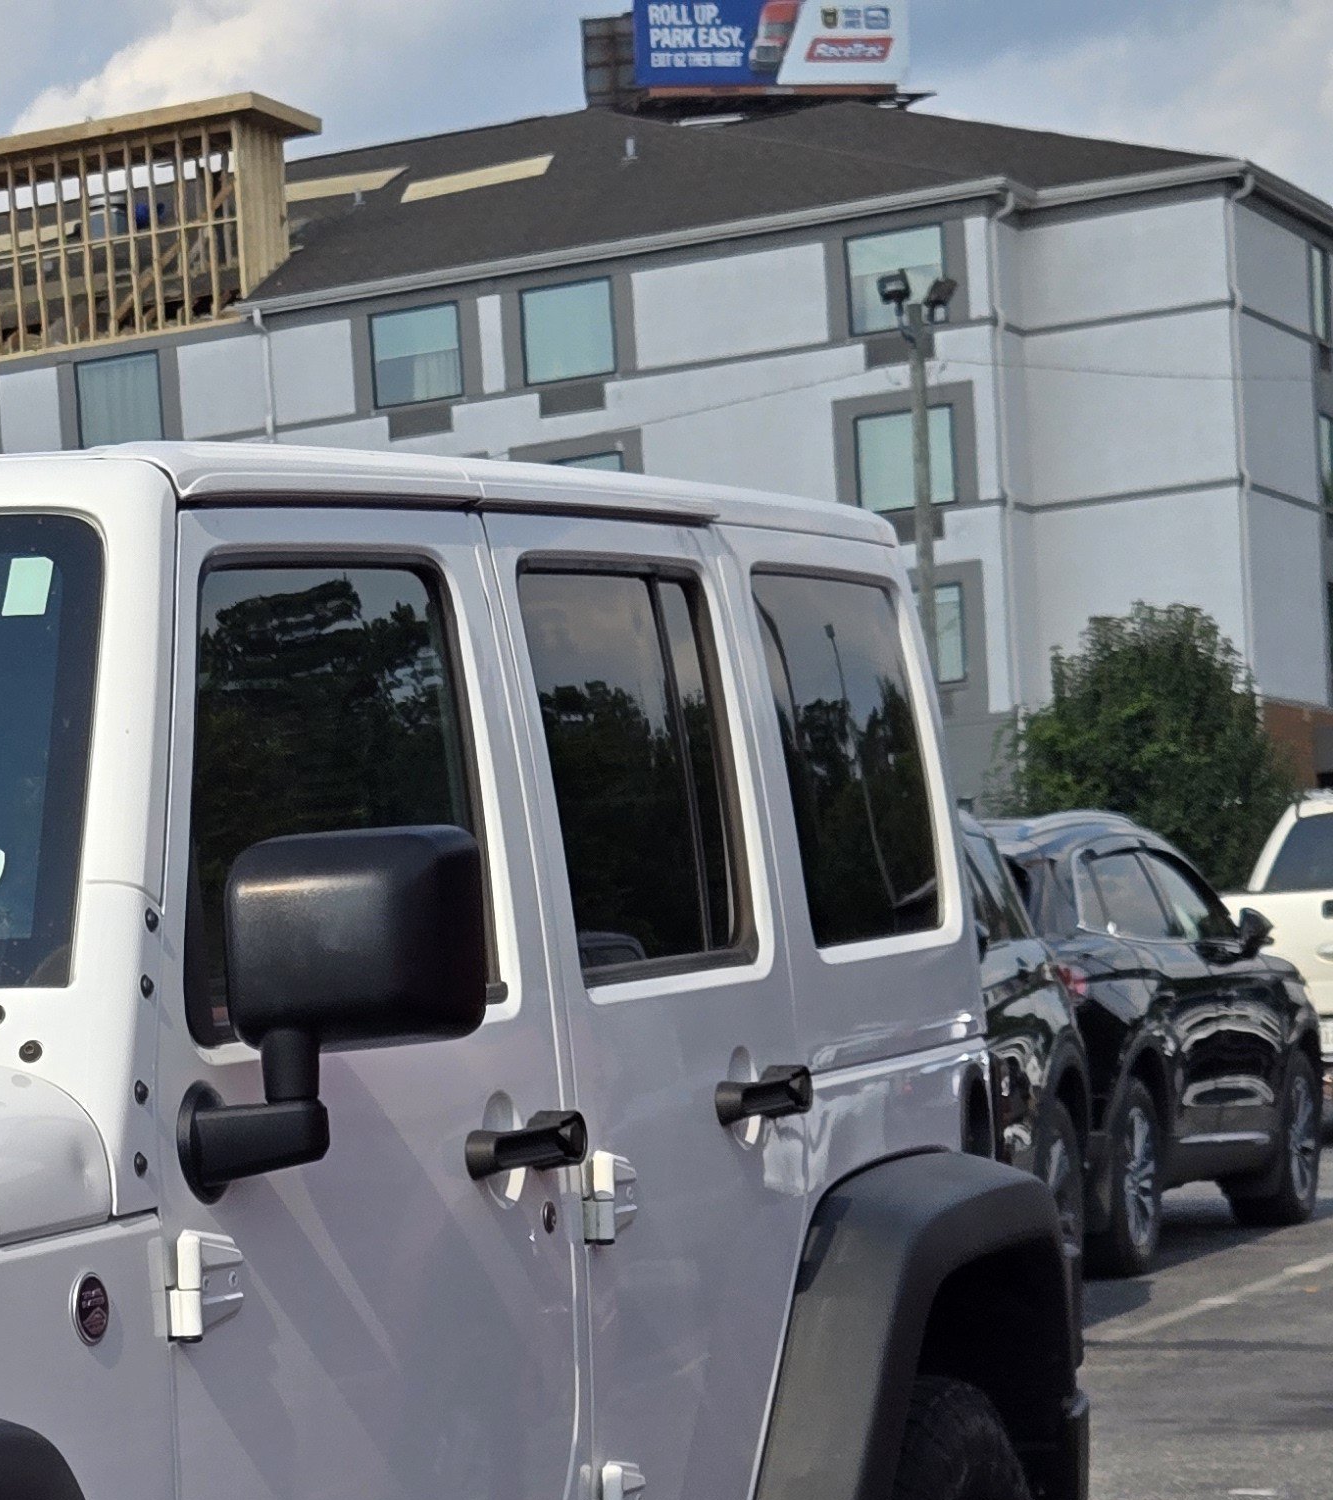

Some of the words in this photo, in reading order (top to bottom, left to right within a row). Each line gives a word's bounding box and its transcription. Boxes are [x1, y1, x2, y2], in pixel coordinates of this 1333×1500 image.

[648, 4, 692, 25] ROLL
[693, 4, 722, 25] UP.
[649, 27, 696, 48] PARK
[698, 26, 745, 48] EASY.
